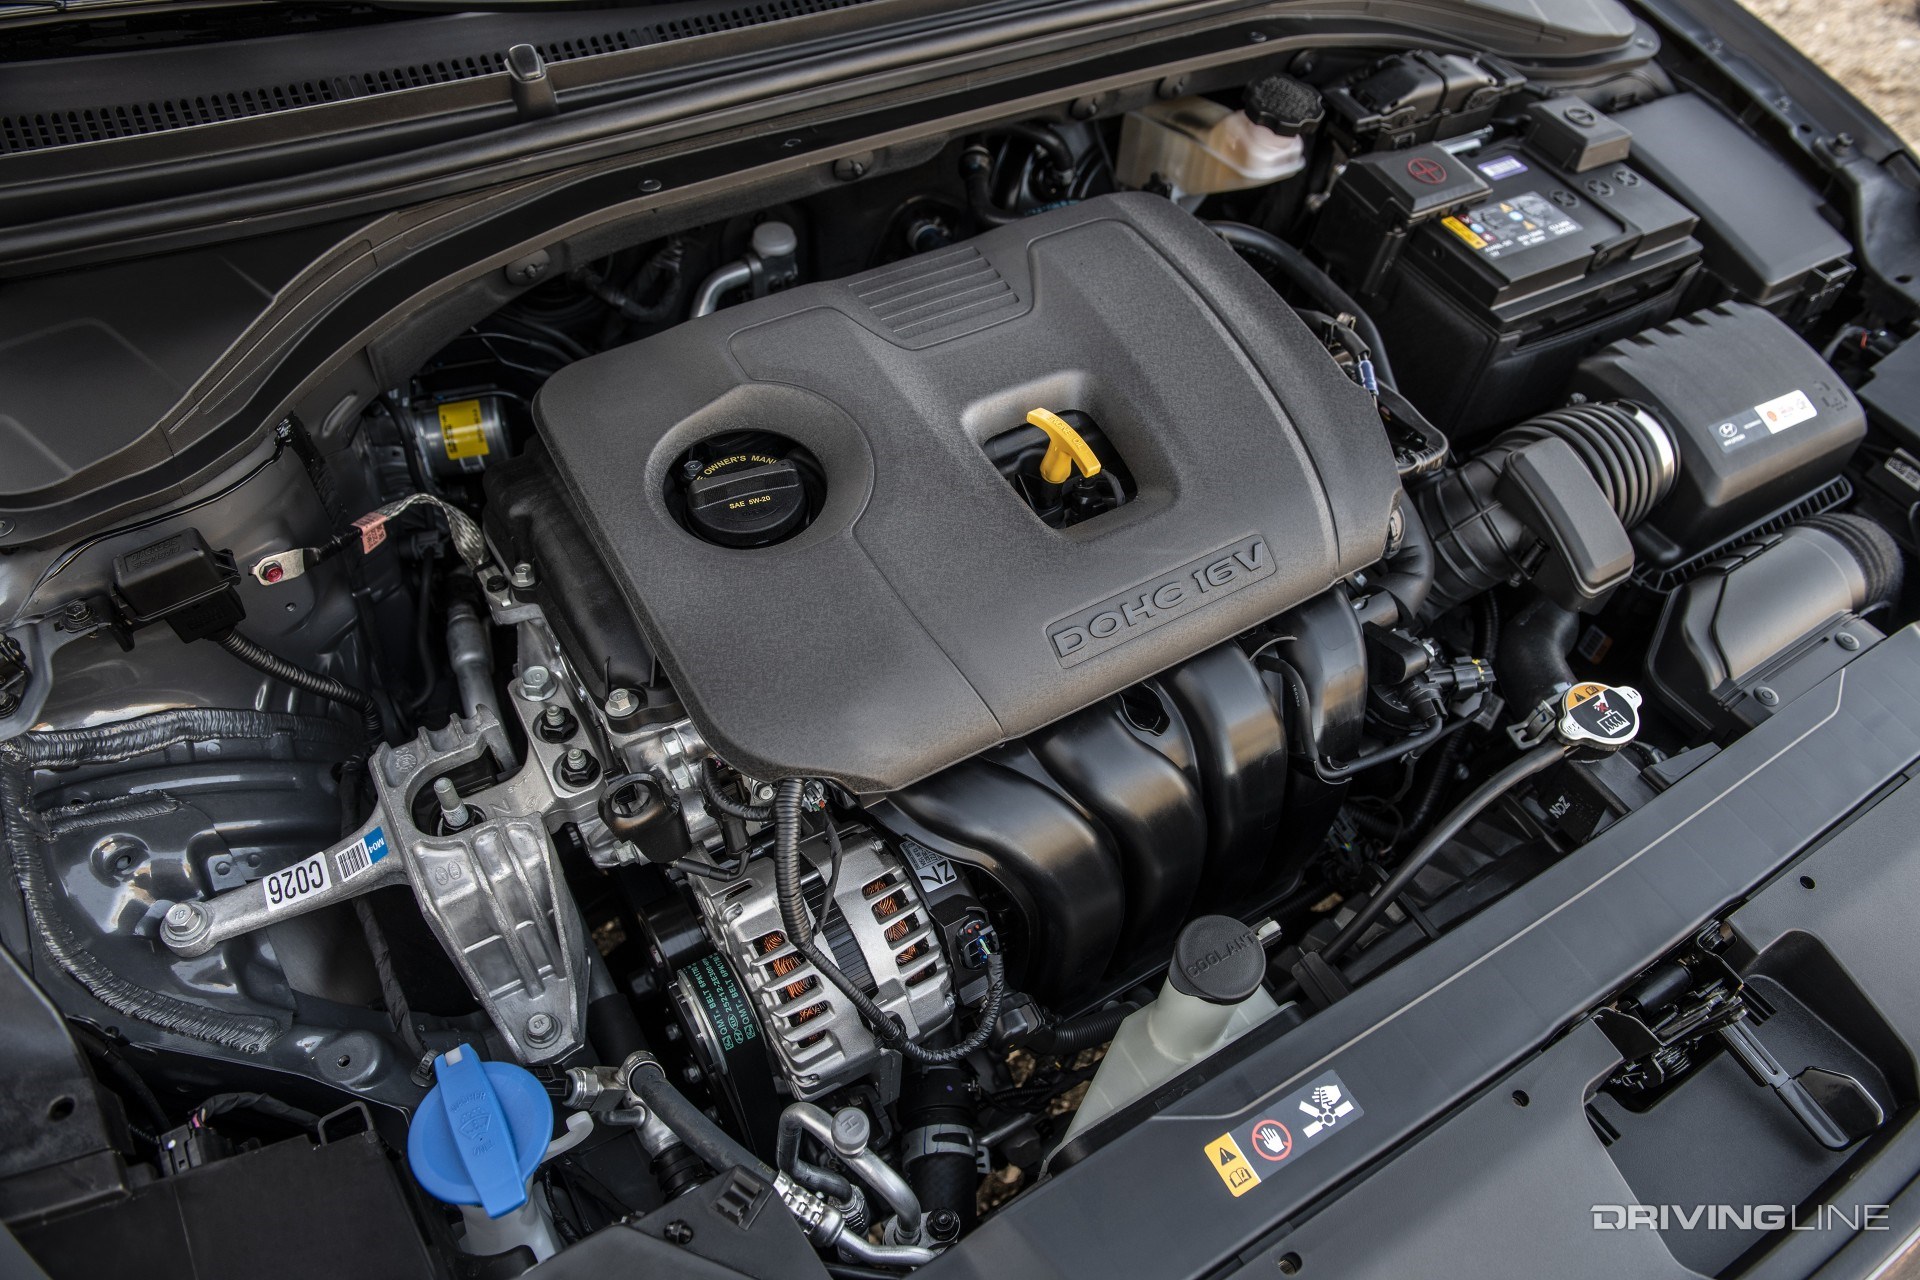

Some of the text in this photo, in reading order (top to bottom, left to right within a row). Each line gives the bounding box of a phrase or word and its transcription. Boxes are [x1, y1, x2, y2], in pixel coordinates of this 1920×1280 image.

[704, 455, 747, 475] OWNER'S
[729, 495, 771, 510] SAE 5W-20
[1052, 541, 1263, 658] DOHC 16V
[368, 838, 384, 853] M04
[268, 860, 324, 904] C026
[1187, 932, 1255, 977] COOLANT
[725, 978, 738, 998] BELT
[702, 989, 716, 1009] BELT
[728, 1015, 737, 1027] KIA
[841, 1115, 860, 1133] H
